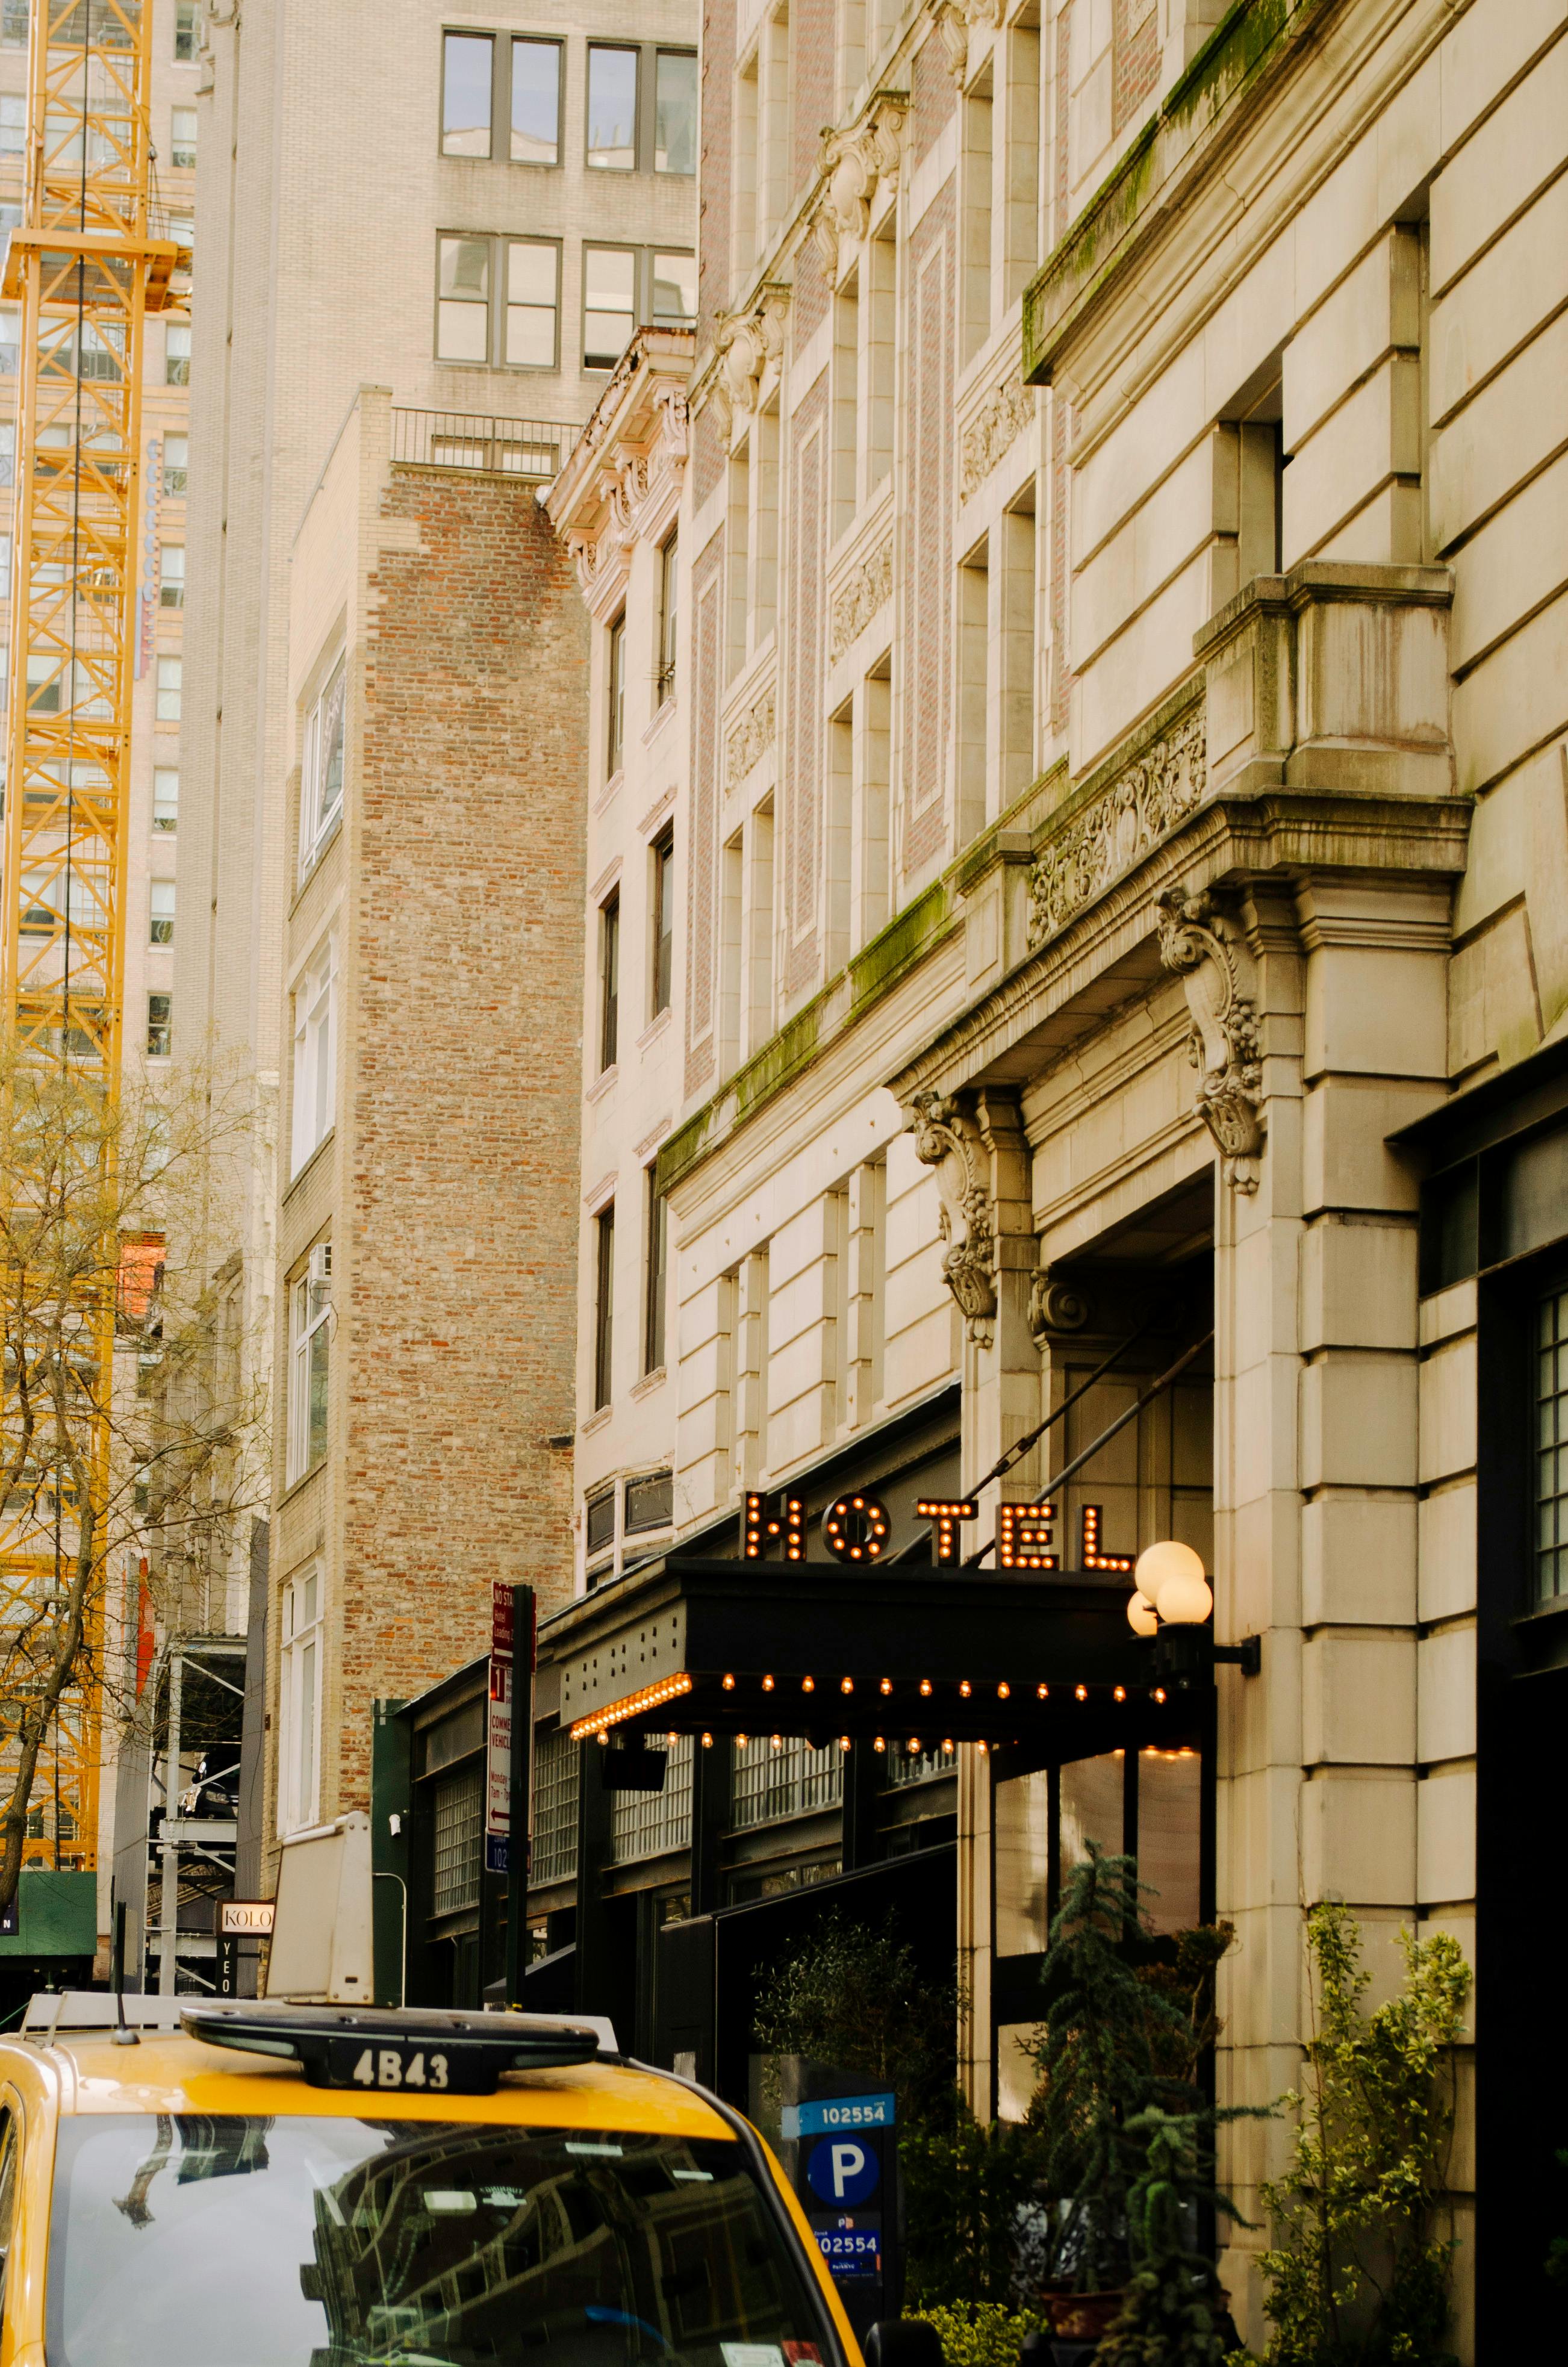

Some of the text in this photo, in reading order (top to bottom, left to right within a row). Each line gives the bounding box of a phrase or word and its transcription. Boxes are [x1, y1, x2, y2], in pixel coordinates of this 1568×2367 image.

[743, 1491, 1135, 1571] HOTEL
[494, 1589, 503, 1605] NO
[494, 1625, 511, 1643] Loading
[491, 1771, 508, 1787] Monday
[491, 1785, 500, 1799] 7am
[225, 1911, 272, 1927] KOLO
[353, 2048, 449, 2088] 4B43
[823, 2106, 885, 2124] 102554
[832, 2144, 865, 2198] P
